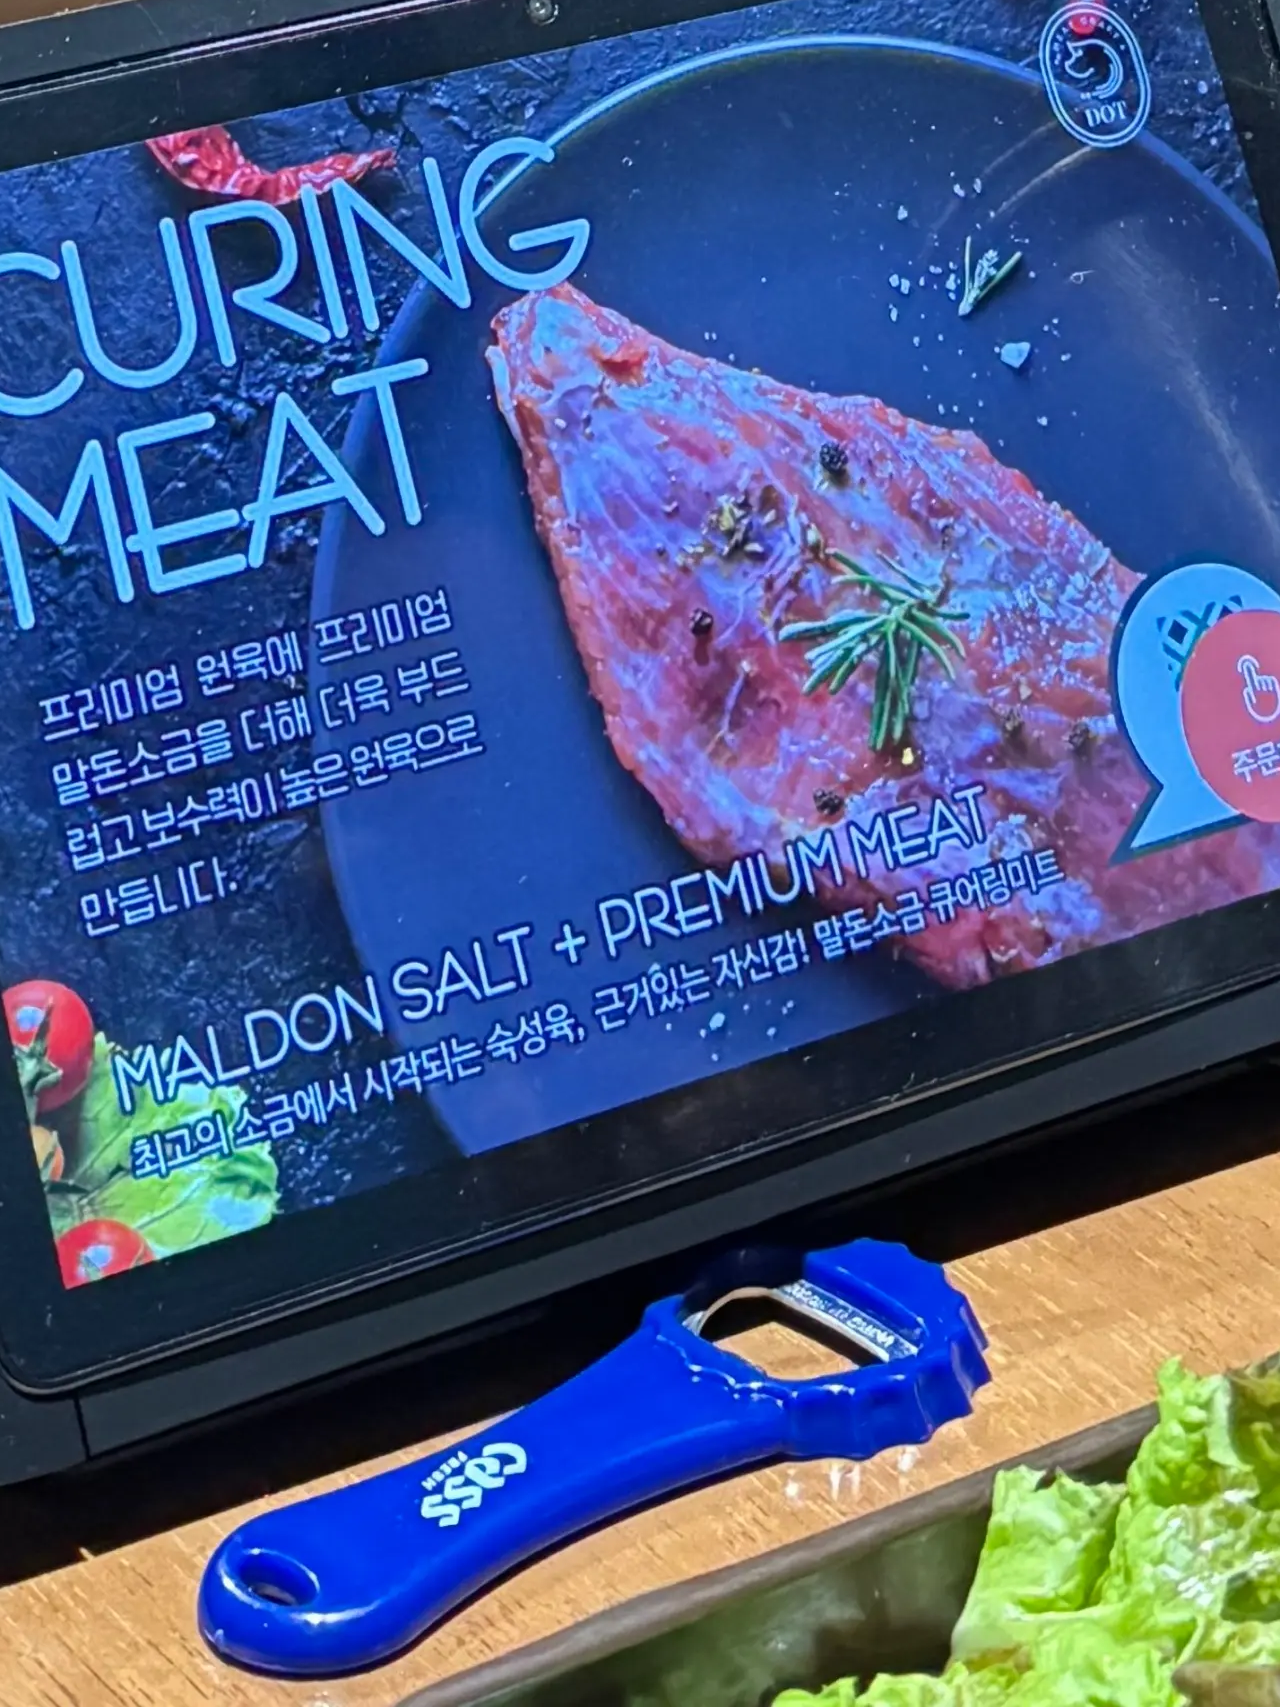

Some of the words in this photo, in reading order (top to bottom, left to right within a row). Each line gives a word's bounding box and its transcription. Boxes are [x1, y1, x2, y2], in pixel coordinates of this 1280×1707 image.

[1084, 100, 1128, 128] DOT
[38, 665, 185, 742] 프리미엄
[196, 632, 304, 696] 원육에
[314, 589, 453, 663] 프리미엄
[52, 718, 234, 806] 말돈소금을
[240, 696, 313, 752] 더해
[319, 673, 390, 728] 더욱
[396, 651, 471, 704] 부드
[66, 814, 142, 872] 럽고
[141, 771, 278, 849] 보수력이
[350, 714, 484, 784] 원육으로
[79, 856, 238, 938] 만듭니다.
[111, 975, 385, 1113] MALDON
[391, 925, 529, 1021] SALT
[554, 924, 588, 964] +
[600, 833, 844, 957] PREMIUM
[853, 786, 988, 879] MEAT
[131, 1112, 233, 1179] 최고의
[235, 1071, 359, 1148] 소금에서
[362, 1036, 483, 1103] 시작되는
[485, 1002, 587, 1065] 숙성육,
[594, 962, 712, 1034] 근거있는
[711, 928, 812, 989] 자신감!
[814, 887, 926, 956] 말돈소금
[928, 848, 1066, 925] 큐어링미트
